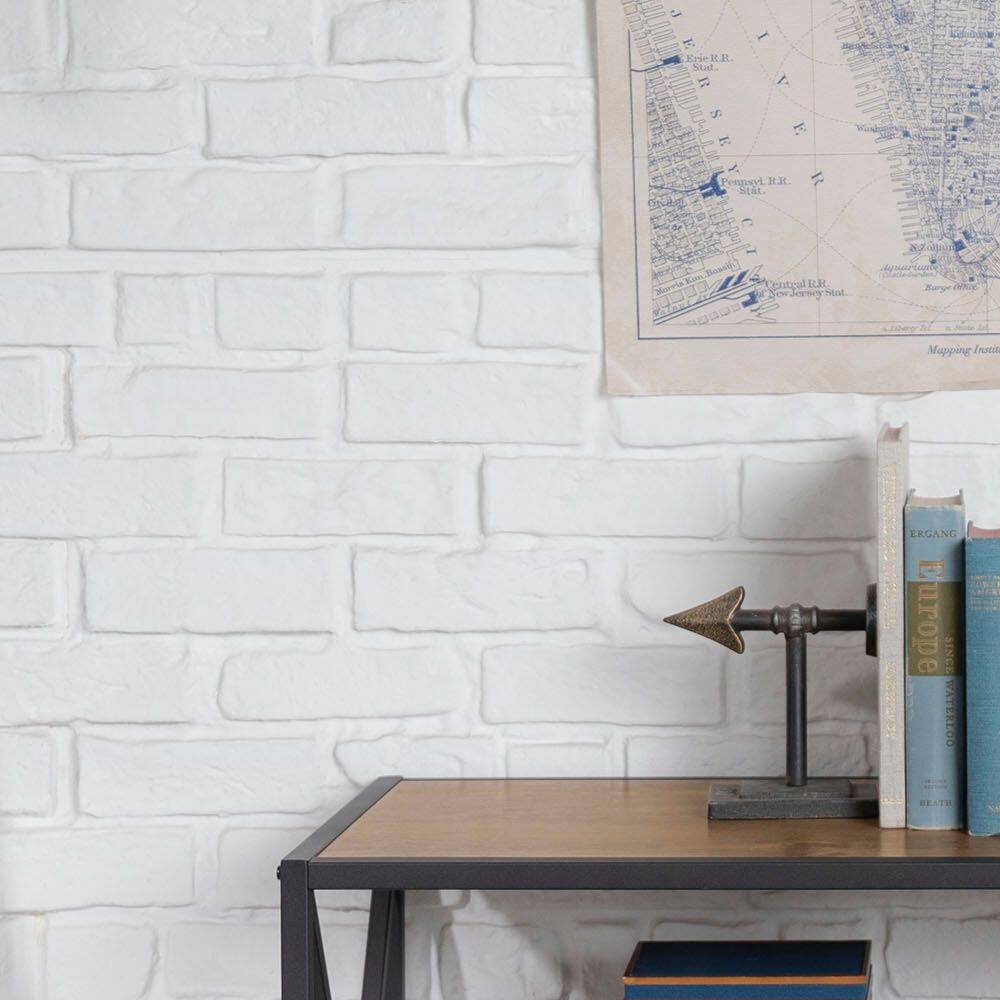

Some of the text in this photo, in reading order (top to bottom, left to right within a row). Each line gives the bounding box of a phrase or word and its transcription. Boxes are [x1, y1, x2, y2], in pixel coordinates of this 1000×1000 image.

[686, 54, 709, 63] Erie
[927, 345, 972, 357] Mapping
[910, 529, 957, 538] ERGANG
[912, 560, 945, 674] Europe
[944, 636, 955, 748] SINCE WATERLOO
